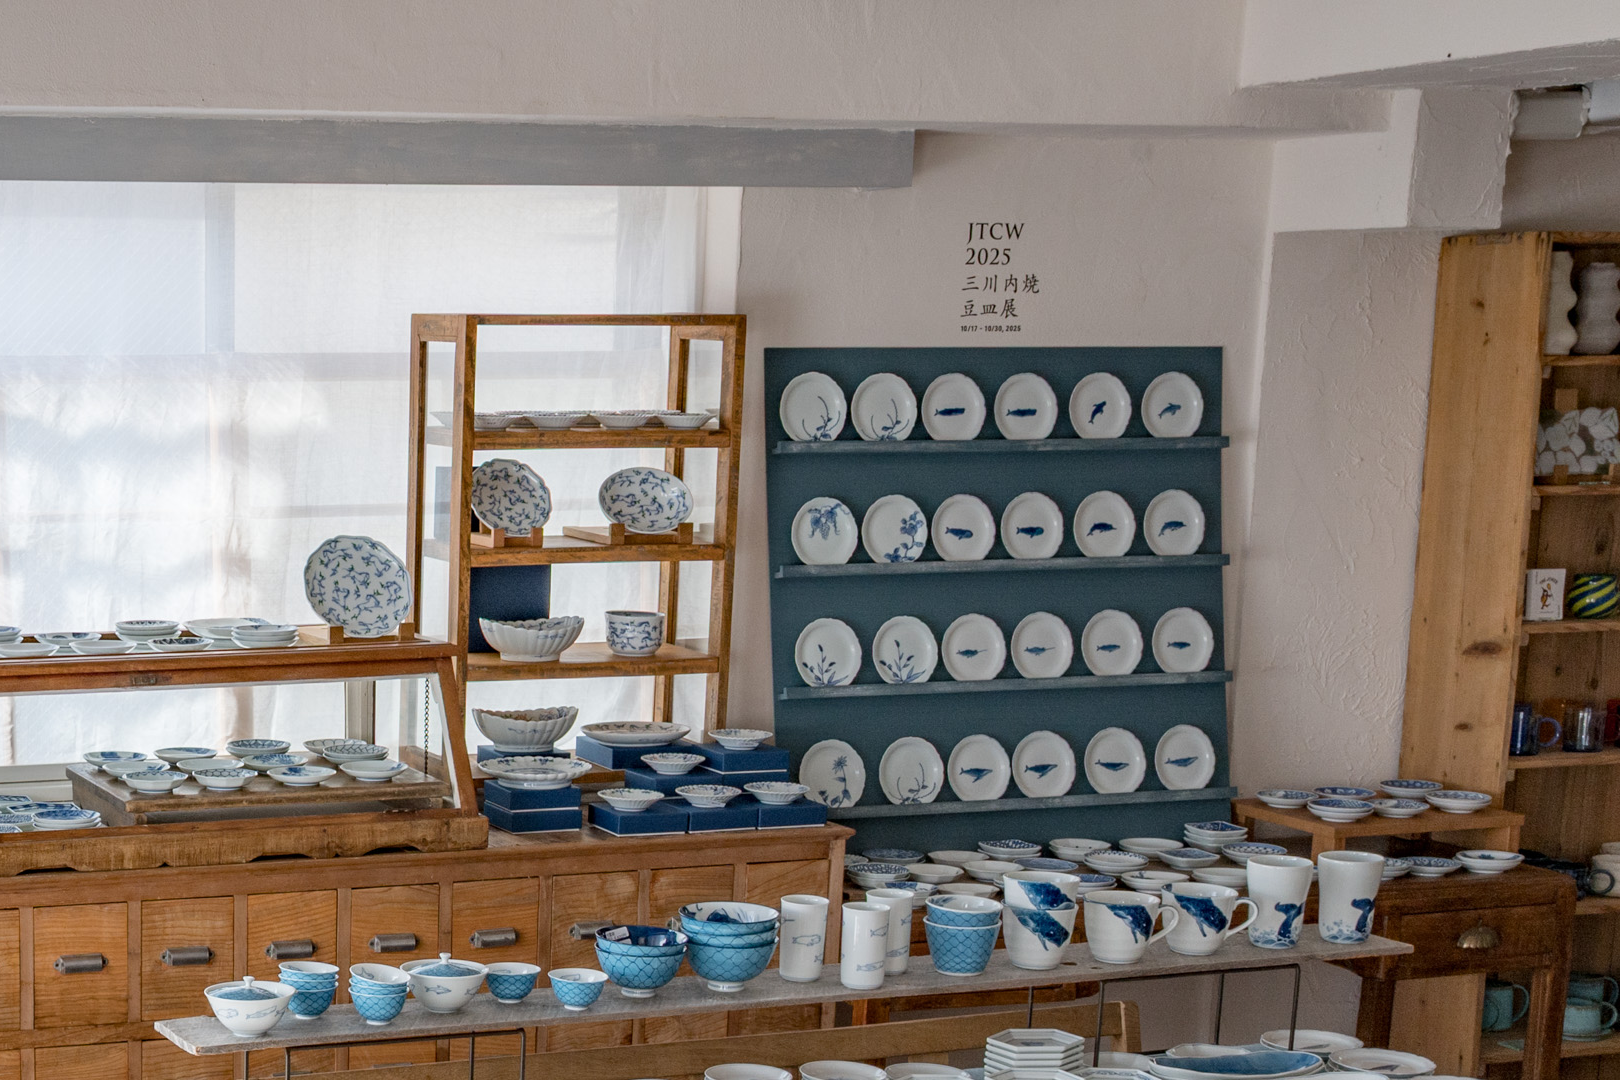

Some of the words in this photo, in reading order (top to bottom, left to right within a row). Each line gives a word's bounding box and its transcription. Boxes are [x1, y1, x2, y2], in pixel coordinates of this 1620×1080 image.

[967, 222, 1025, 244] JTCW
[965, 247, 1011, 266] 2025
[961, 273, 1040, 294] 三川内焼
[960, 298, 1018, 319] 豆皿展
[984, 325, 1005, 334] 10/30,
[1005, 324, 1022, 332] 2025
